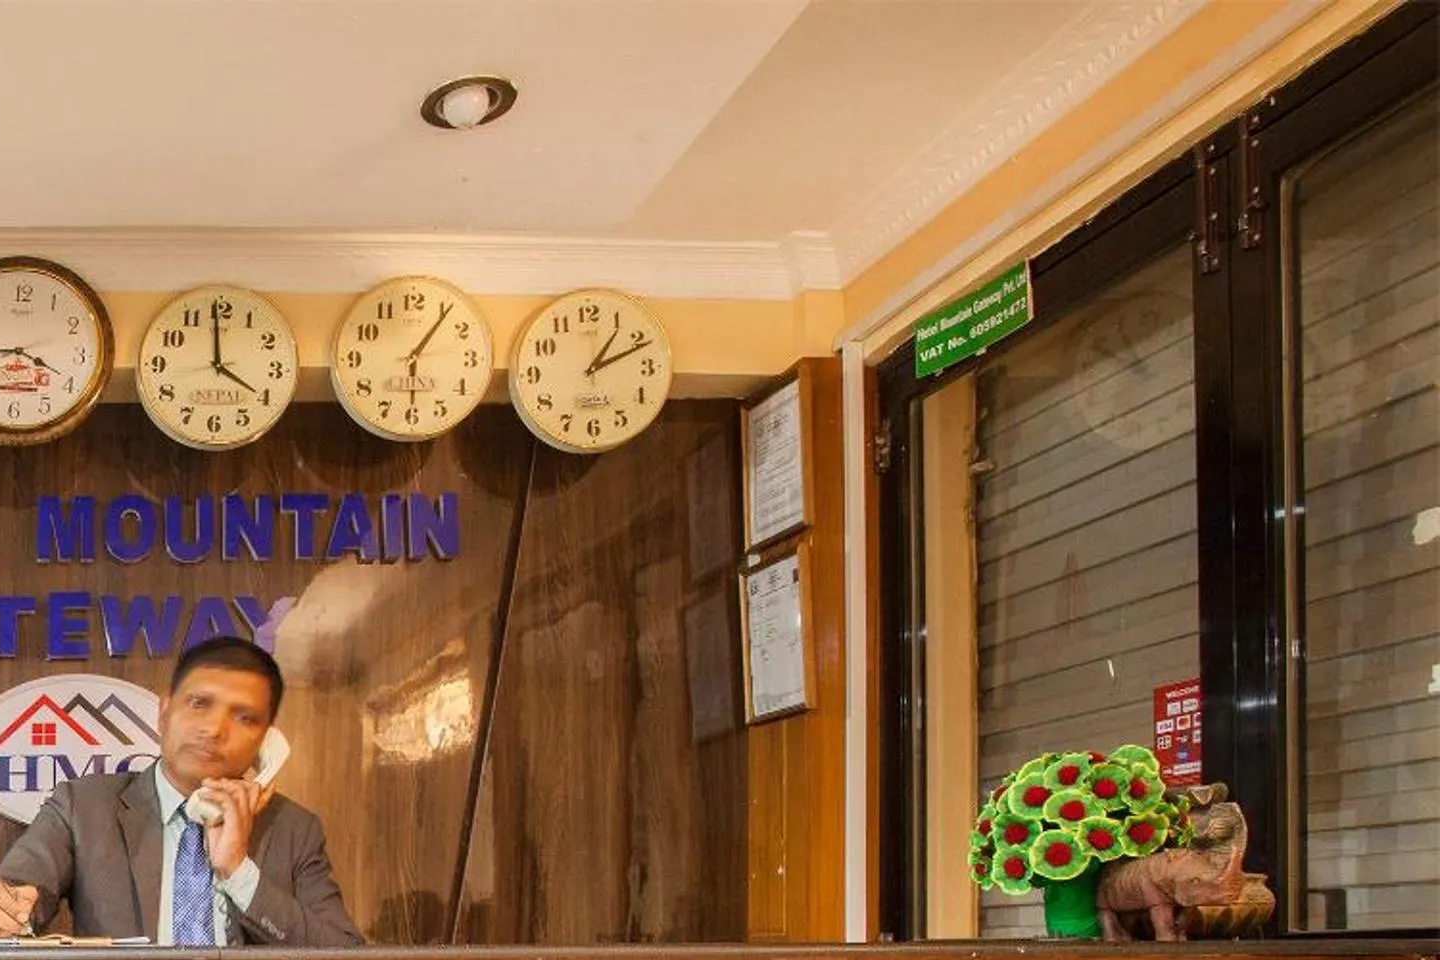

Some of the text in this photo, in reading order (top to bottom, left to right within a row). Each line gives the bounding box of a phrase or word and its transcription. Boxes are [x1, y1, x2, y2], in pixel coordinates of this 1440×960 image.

[15, 284, 34, 302] 12
[51, 293, 57, 311] 1
[377, 301, 393, 319] 11
[404, 293, 426, 312] 12
[183, 309, 200, 327] 11
[246, 310, 253, 329] 1
[578, 304, 600, 323] 12
[613, 311, 620, 329] 1
[67, 316, 80, 335] 2
[358, 323, 380, 342] 10
[454, 322, 470, 339] 2
[553, 316, 569, 333] 11
[162, 330, 185, 348] 10
[261, 333, 276, 350] 2
[535, 338, 556, 357] 10
[73, 346, 86, 366] 3
[347, 350, 362, 368] 9
[464, 350, 478, 368] 3
[919, 343, 945, 362] VAT
[151, 355, 166, 374] 9
[268, 360, 283, 379] 3
[641, 358, 655, 376] 3
[62, 375, 75, 394] 4
[527, 366, 541, 385] 9
[158, 384, 175, 402] 8
[356, 378, 372, 397] 8
[452, 378, 467, 396] 4
[38, 396, 51, 415] 5
[257, 388, 270, 406] 4
[537, 393, 553, 411] 8
[7, 401, 20, 420] 6
[180, 406, 195, 424] 7
[235, 408, 250, 427] 5
[378, 400, 392, 419] 7
[404, 407, 419, 425] 6
[433, 400, 448, 418] 5
[206, 415, 221, 433] 6
[560, 414, 573, 432] 7
[586, 418, 601, 437] 6
[614, 410, 628, 427] 5
[35, 493, 460, 565] MOUNTAIN
